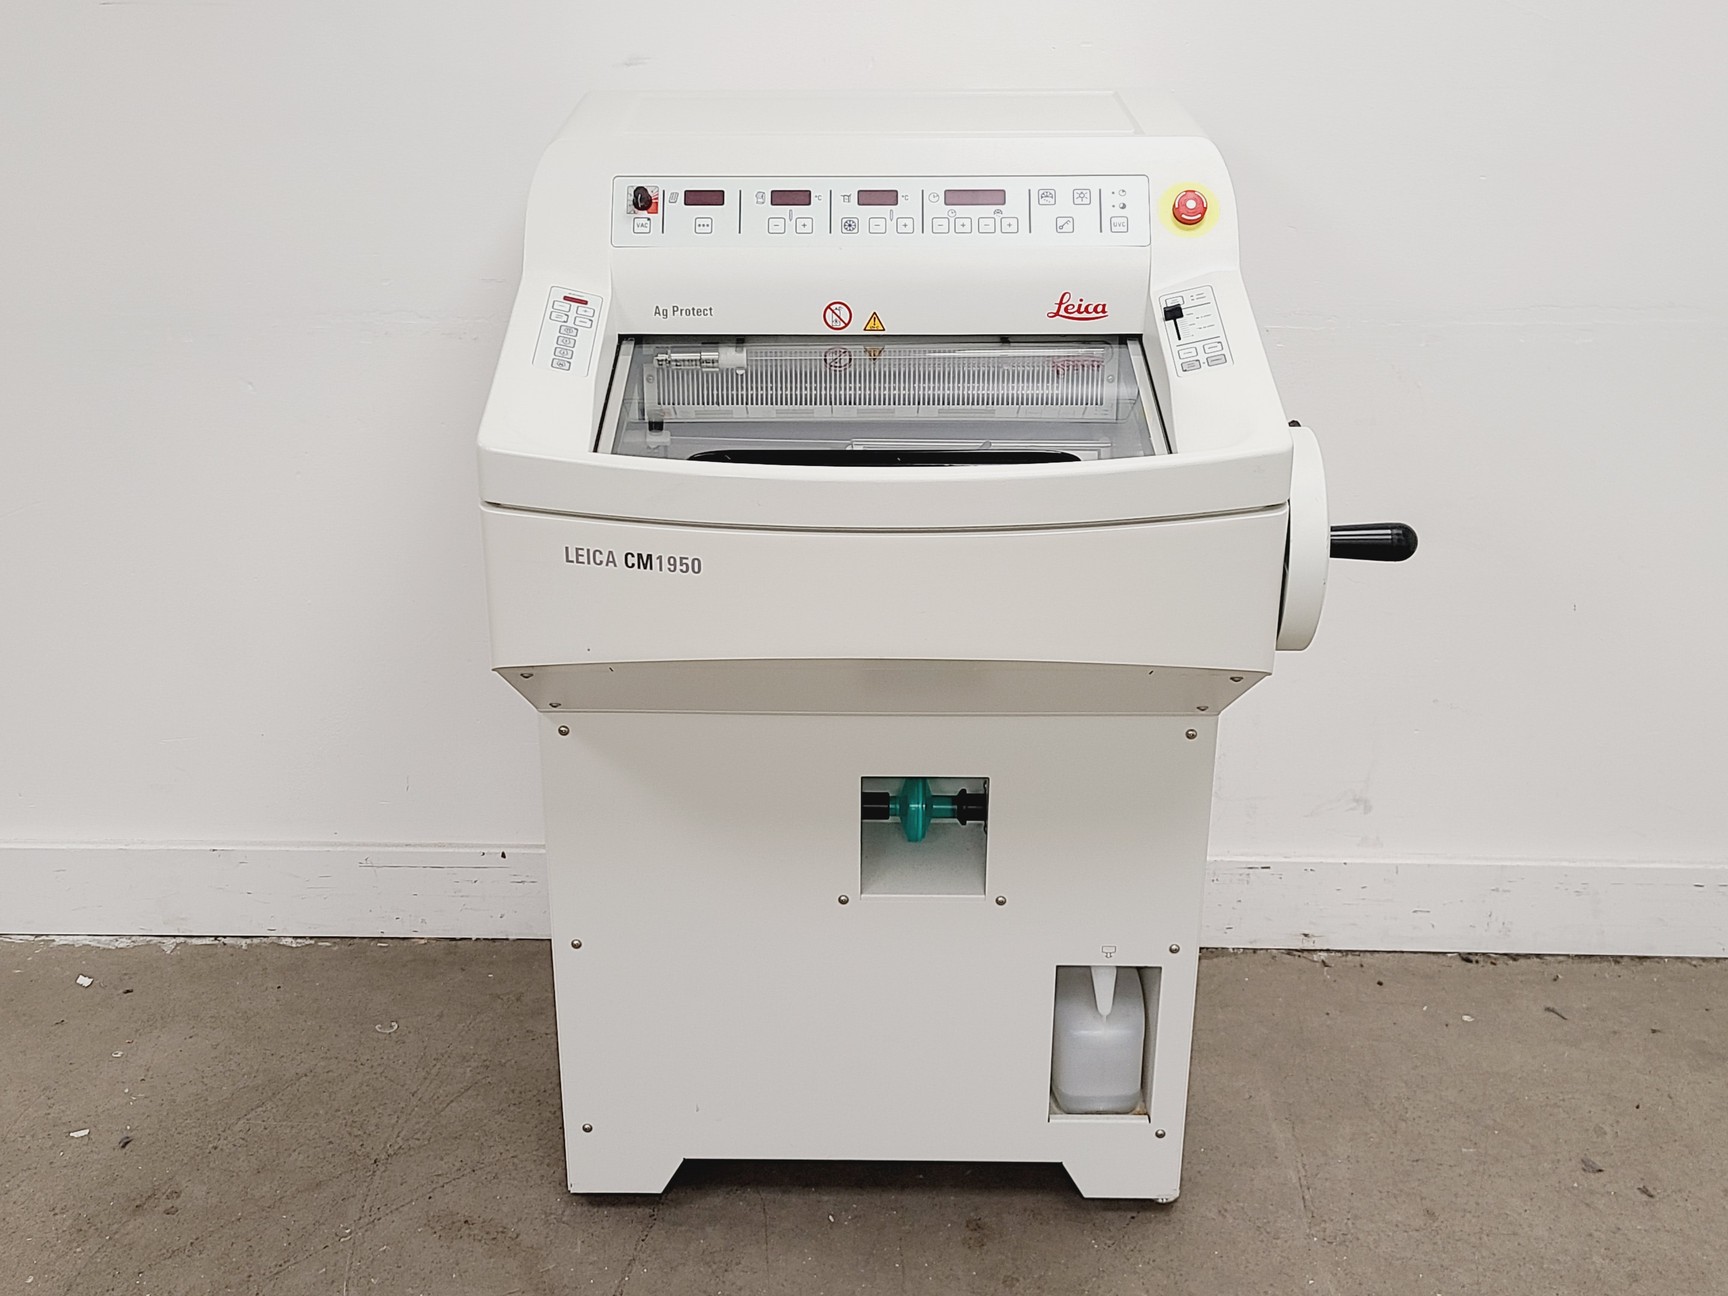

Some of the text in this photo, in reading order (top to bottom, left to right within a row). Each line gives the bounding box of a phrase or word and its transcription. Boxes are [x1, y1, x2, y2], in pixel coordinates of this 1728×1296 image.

[653, 305, 714, 320] Ag Protect
[1046, 291, 1109, 322] Leica
[564, 546, 702, 575] LEICA CM1950
